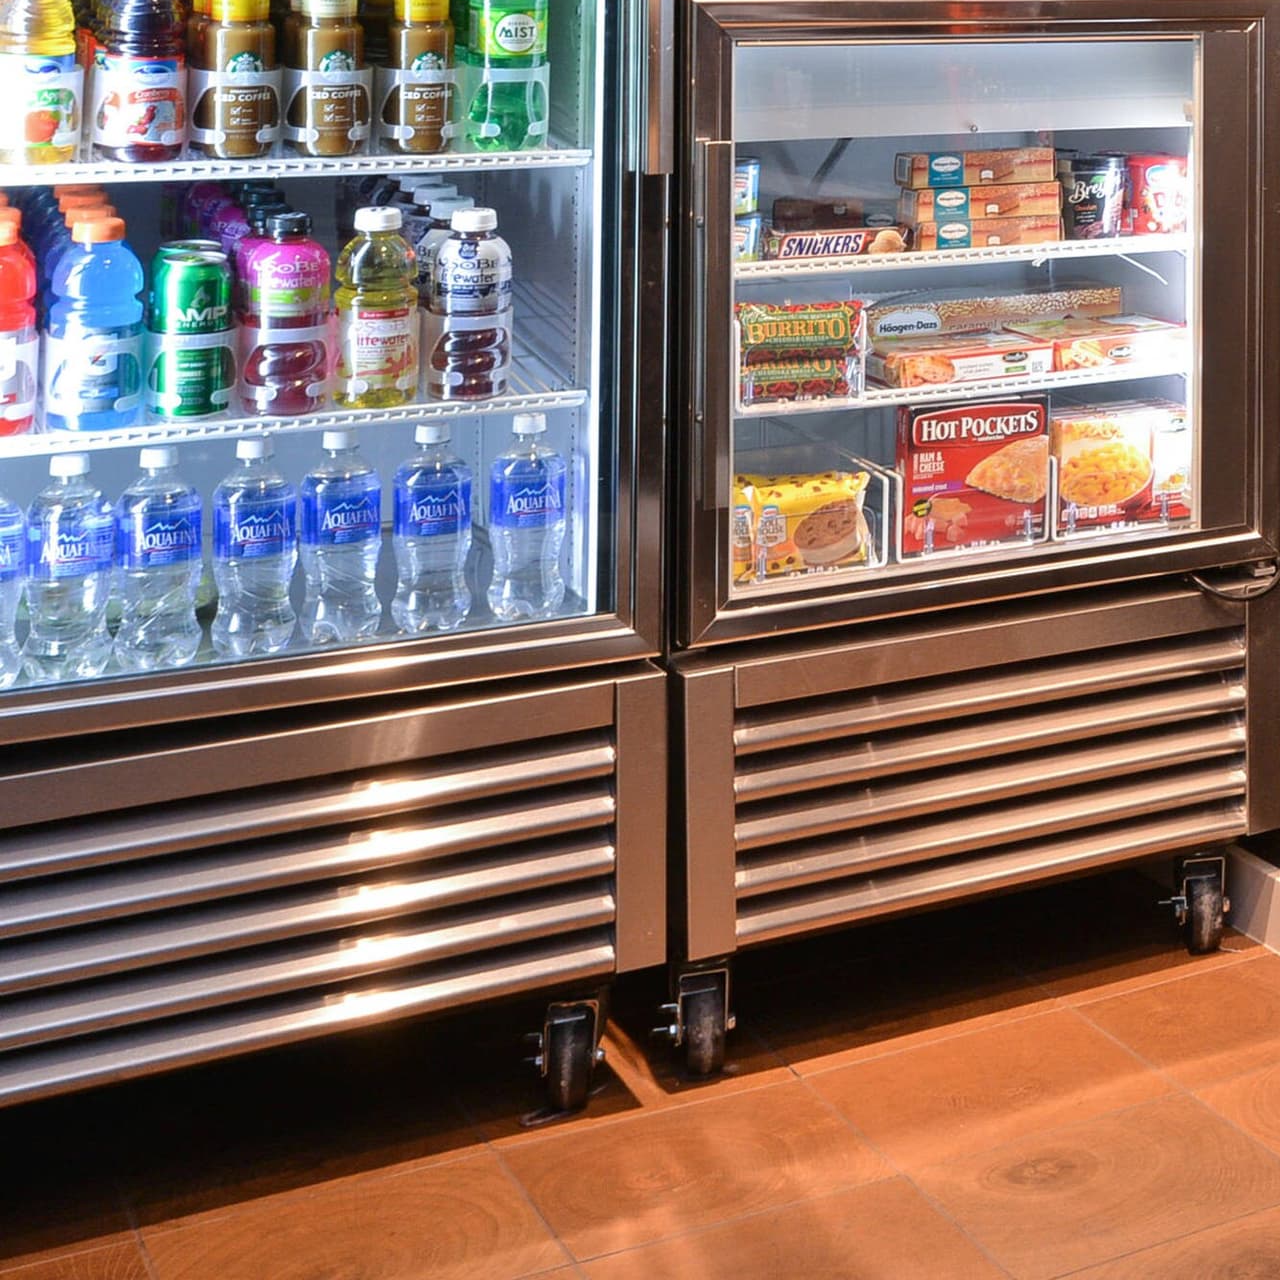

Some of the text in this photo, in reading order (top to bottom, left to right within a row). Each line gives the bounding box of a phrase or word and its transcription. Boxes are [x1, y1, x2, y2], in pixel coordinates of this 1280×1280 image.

[498, 26, 536, 39] MIST
[782, 233, 864, 257] SNICKERS
[746, 317, 846, 344] BURRITO
[920, 410, 1039, 443] HOT POCKETS
[919, 451, 936, 463] HAM
[919, 460, 945, 473] CHEESE
[409, 501, 467, 524] AQUAFINA
[505, 493, 562, 515] AQUAFINA
